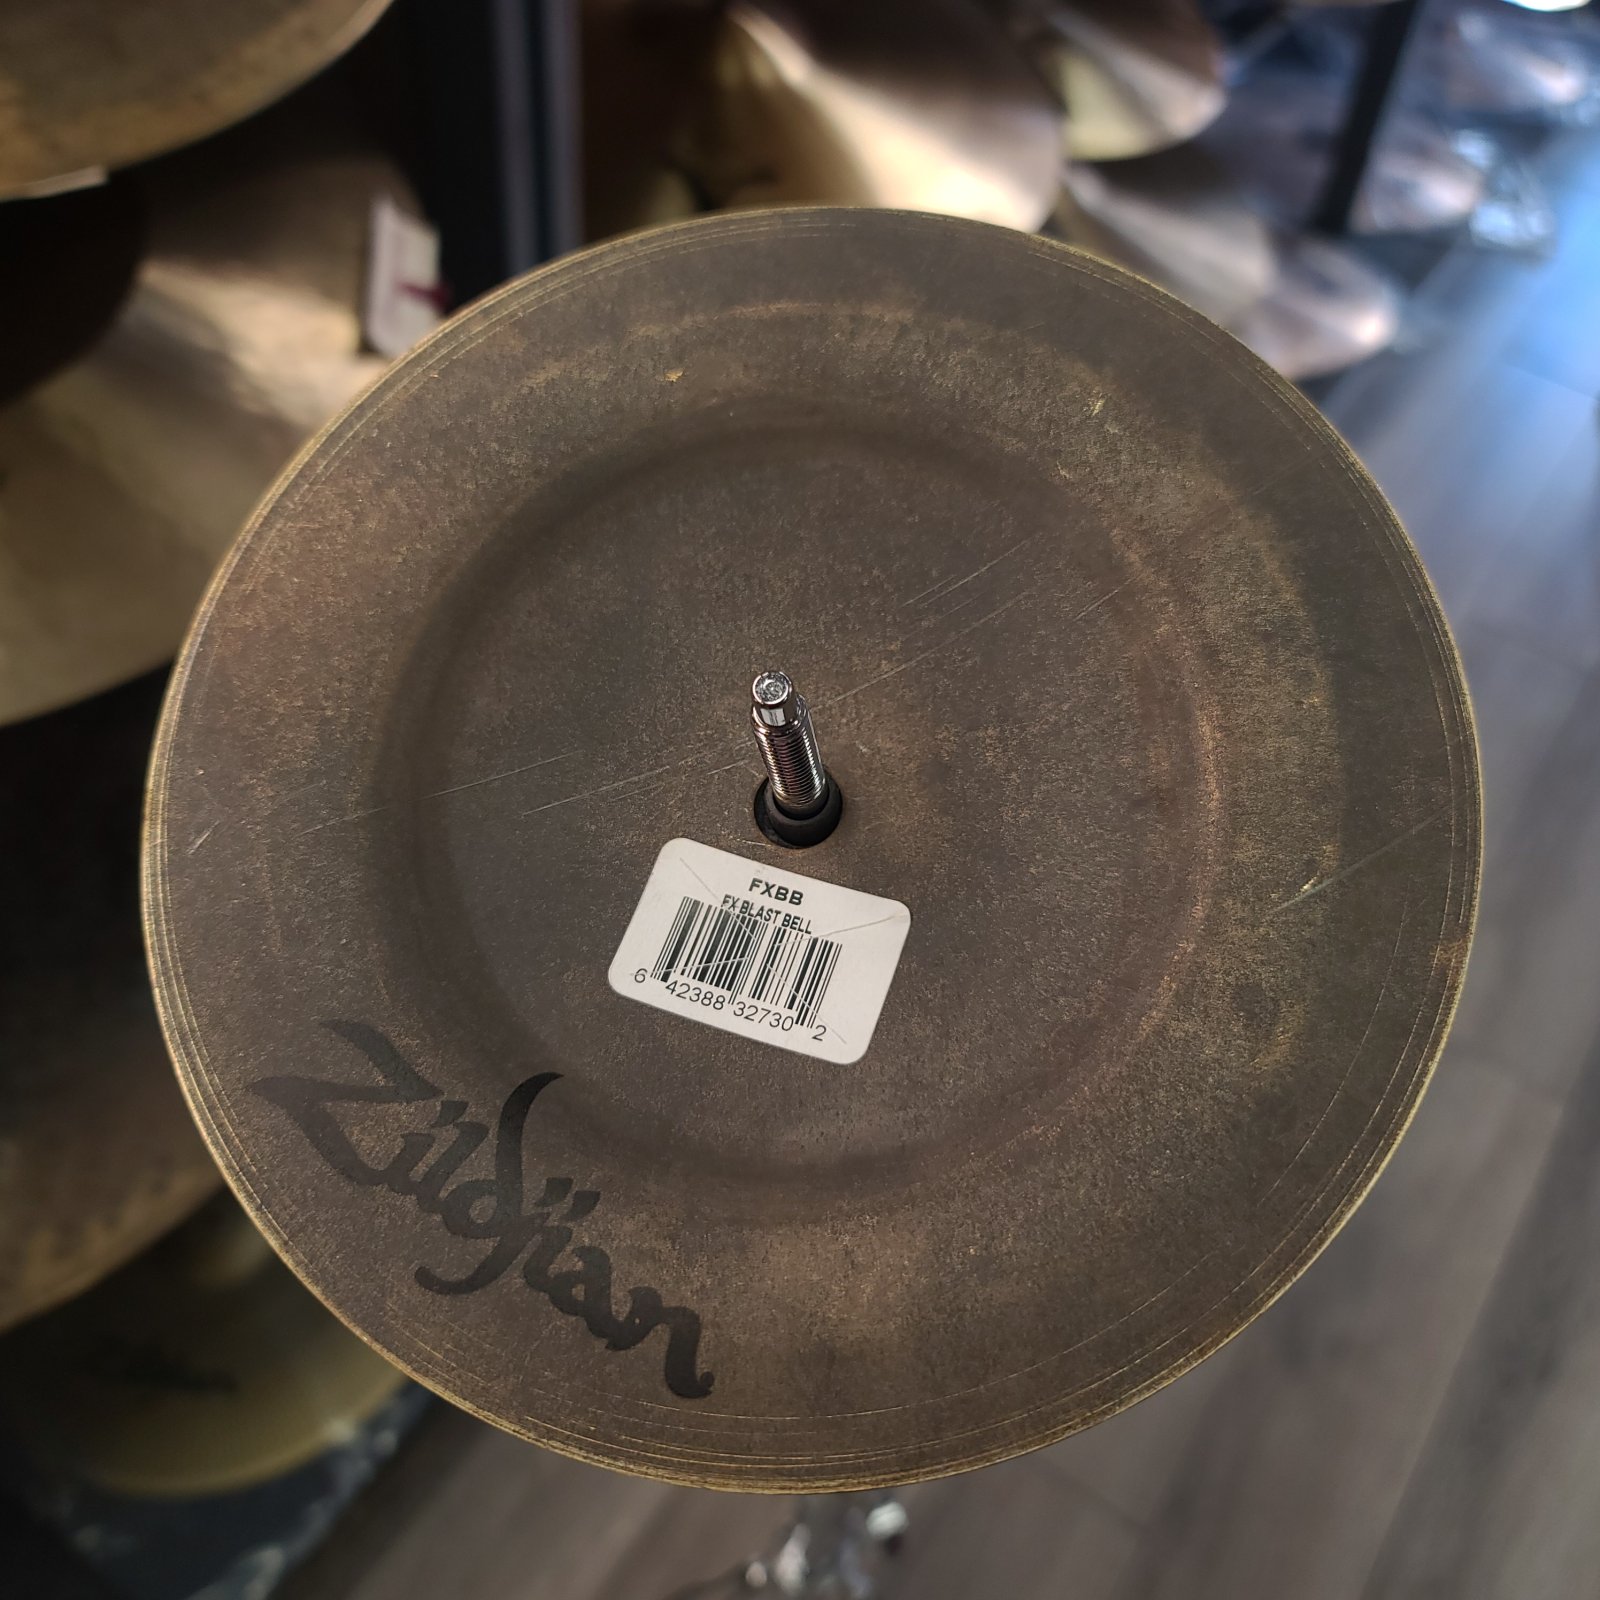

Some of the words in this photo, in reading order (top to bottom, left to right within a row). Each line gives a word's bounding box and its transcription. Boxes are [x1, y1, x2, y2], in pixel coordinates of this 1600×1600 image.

[721, 894, 738, 912] FX
[738, 900, 782, 924] BLAST
[781, 913, 812, 935] BELL
[748, 877, 804, 906] FXBB
[633, 967, 648, 984] 6
[665, 980, 726, 1011] 42388
[732, 1001, 795, 1032] 32730
[811, 1024, 827, 1042] 2
[247, 1019, 715, 1399] Zildjian
